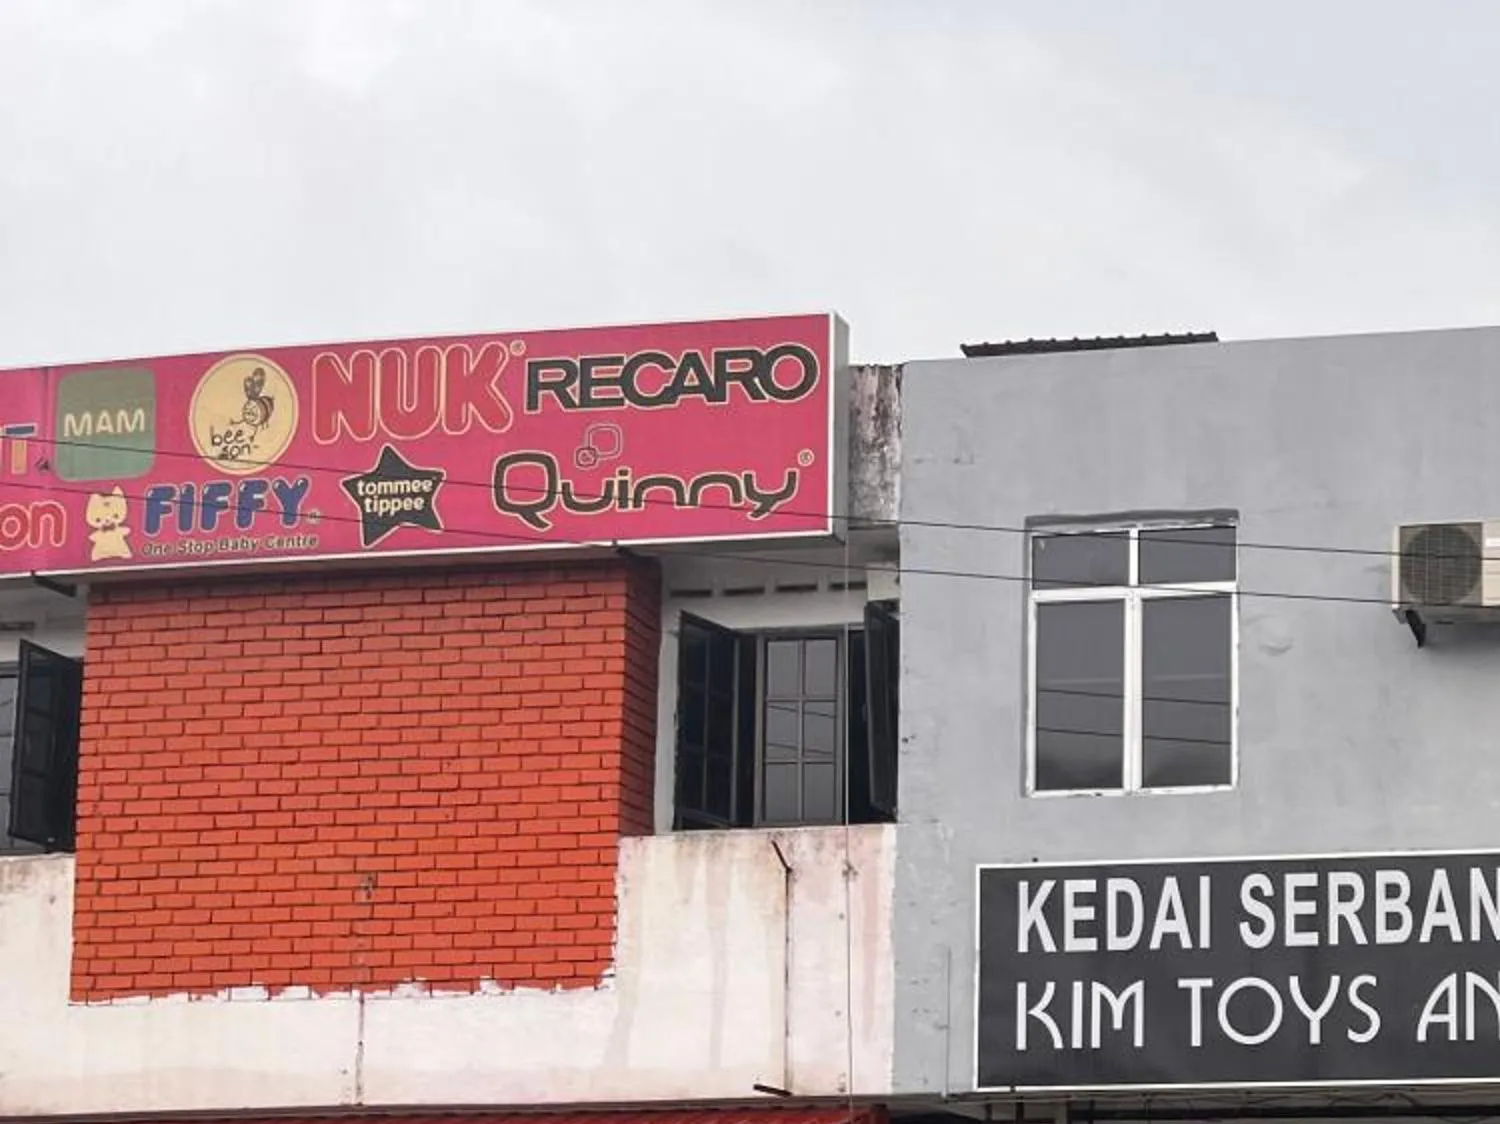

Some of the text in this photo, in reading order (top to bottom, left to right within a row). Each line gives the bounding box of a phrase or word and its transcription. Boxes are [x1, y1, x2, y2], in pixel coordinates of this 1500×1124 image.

[312, 341, 512, 444] NUK
[524, 342, 819, 414] RECARO
[63, 408, 145, 437] MAM
[209, 424, 245, 446] bee
[144, 474, 312, 537] FIFFY
[357, 479, 433, 496] tommee
[364, 496, 425, 516] tippee
[494, 450, 800, 530] Quinny
[177, 538, 216, 555] Stop
[218, 536, 258, 553] Baby
[265, 534, 319, 550] Centre
[1017, 874, 1211, 953] KEDAI
[1016, 979, 1145, 1050] KIM
[1177, 974, 1382, 1048] TOYS
